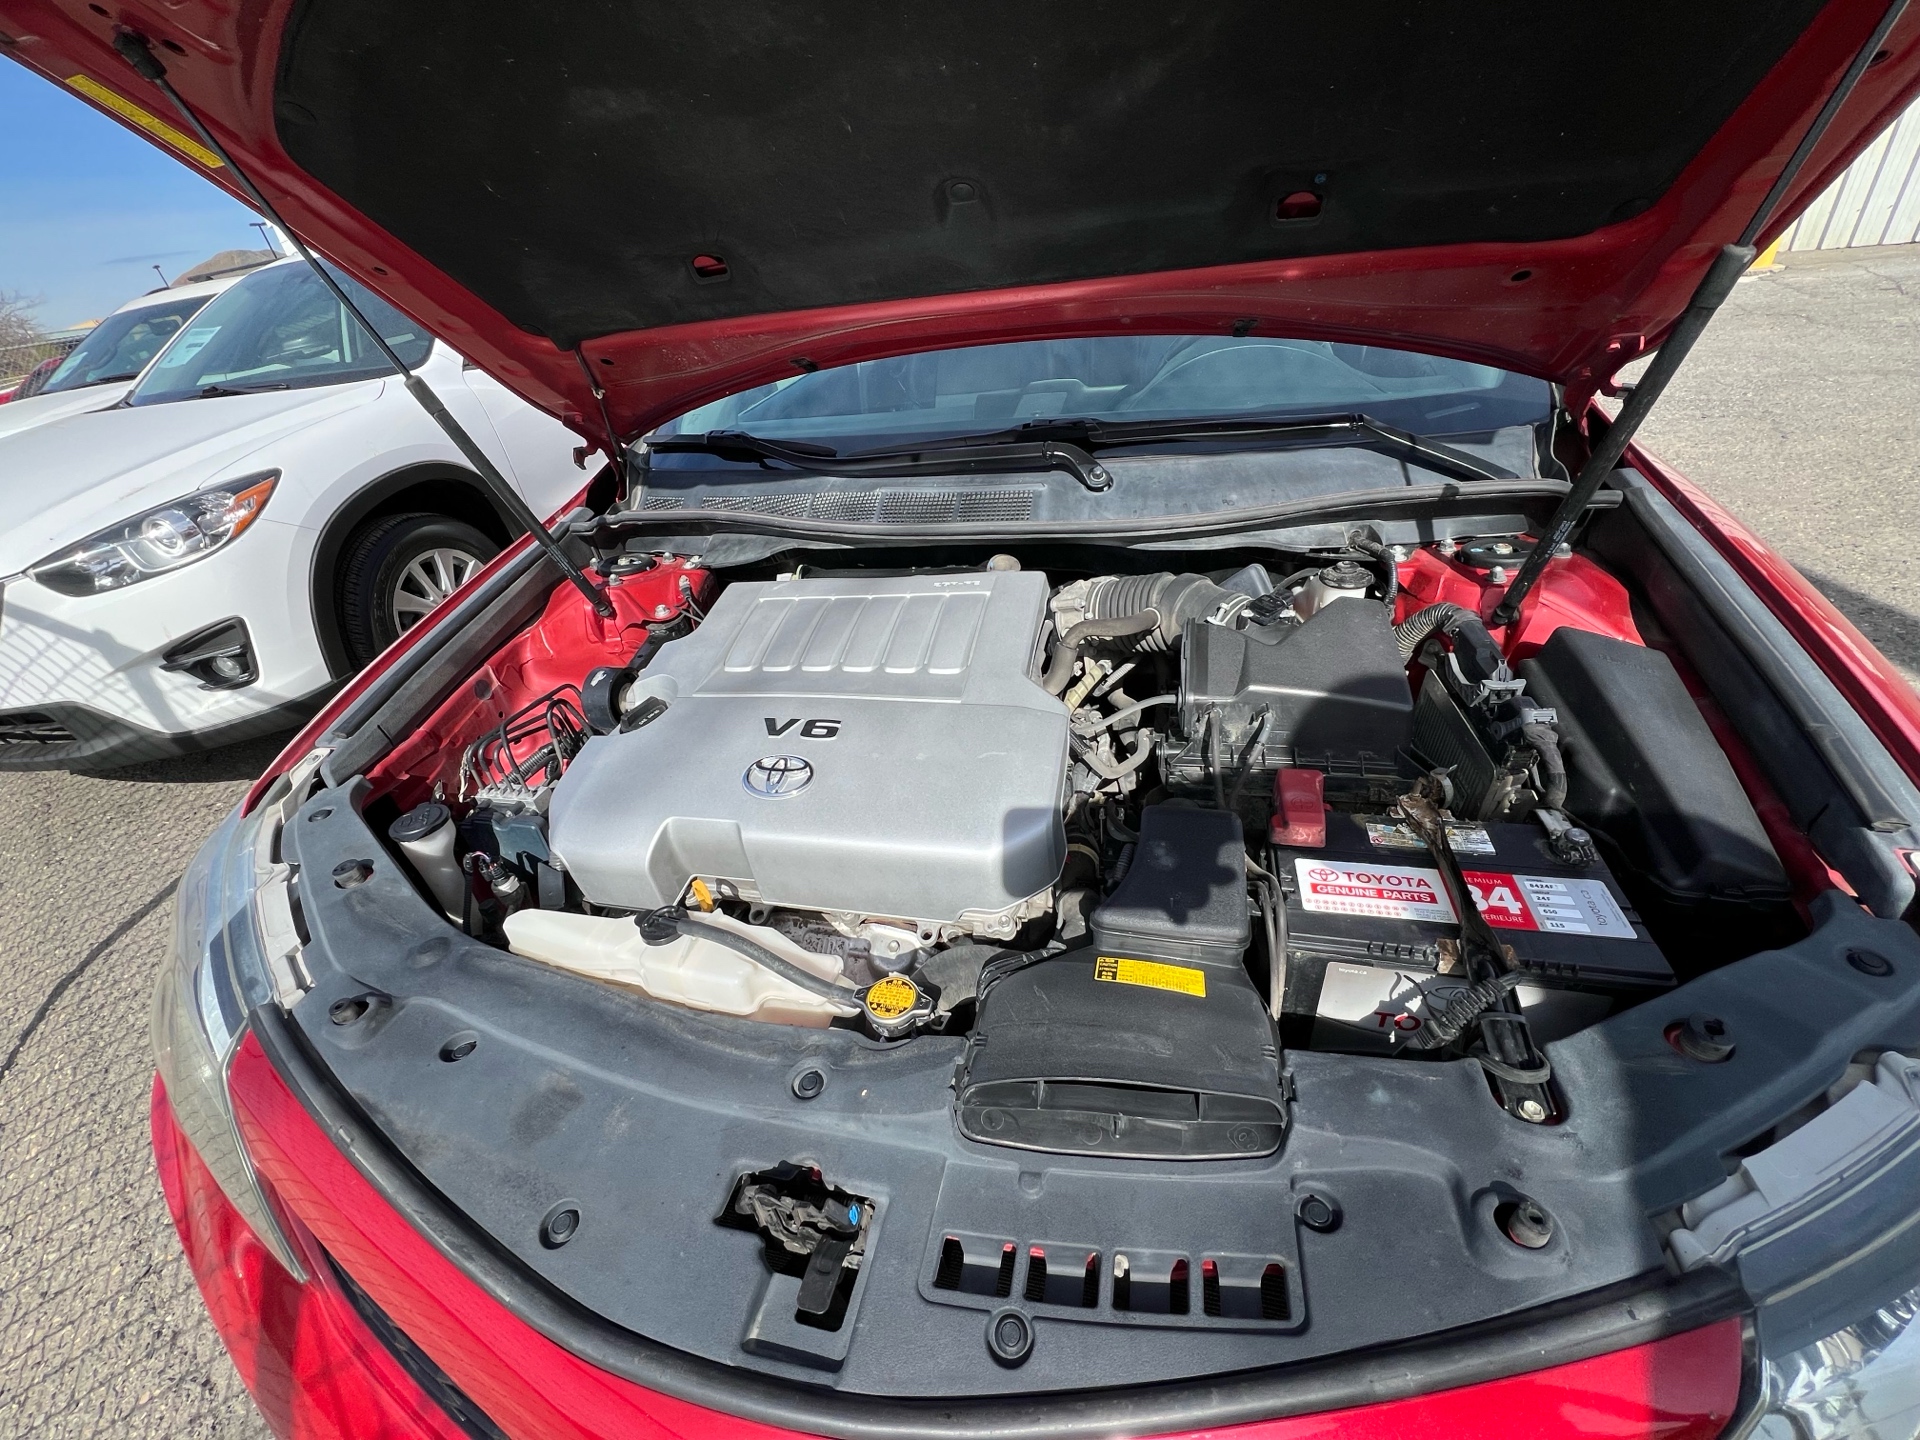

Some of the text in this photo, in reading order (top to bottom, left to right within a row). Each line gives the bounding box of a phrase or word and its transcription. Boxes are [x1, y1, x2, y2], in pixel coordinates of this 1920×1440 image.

[764, 717, 842, 740] V6
[1341, 871, 1432, 889] TOYOTA
[1463, 876, 1503, 885] EMIUM
[1316, 885, 1431, 902] GENUINE PARTS
